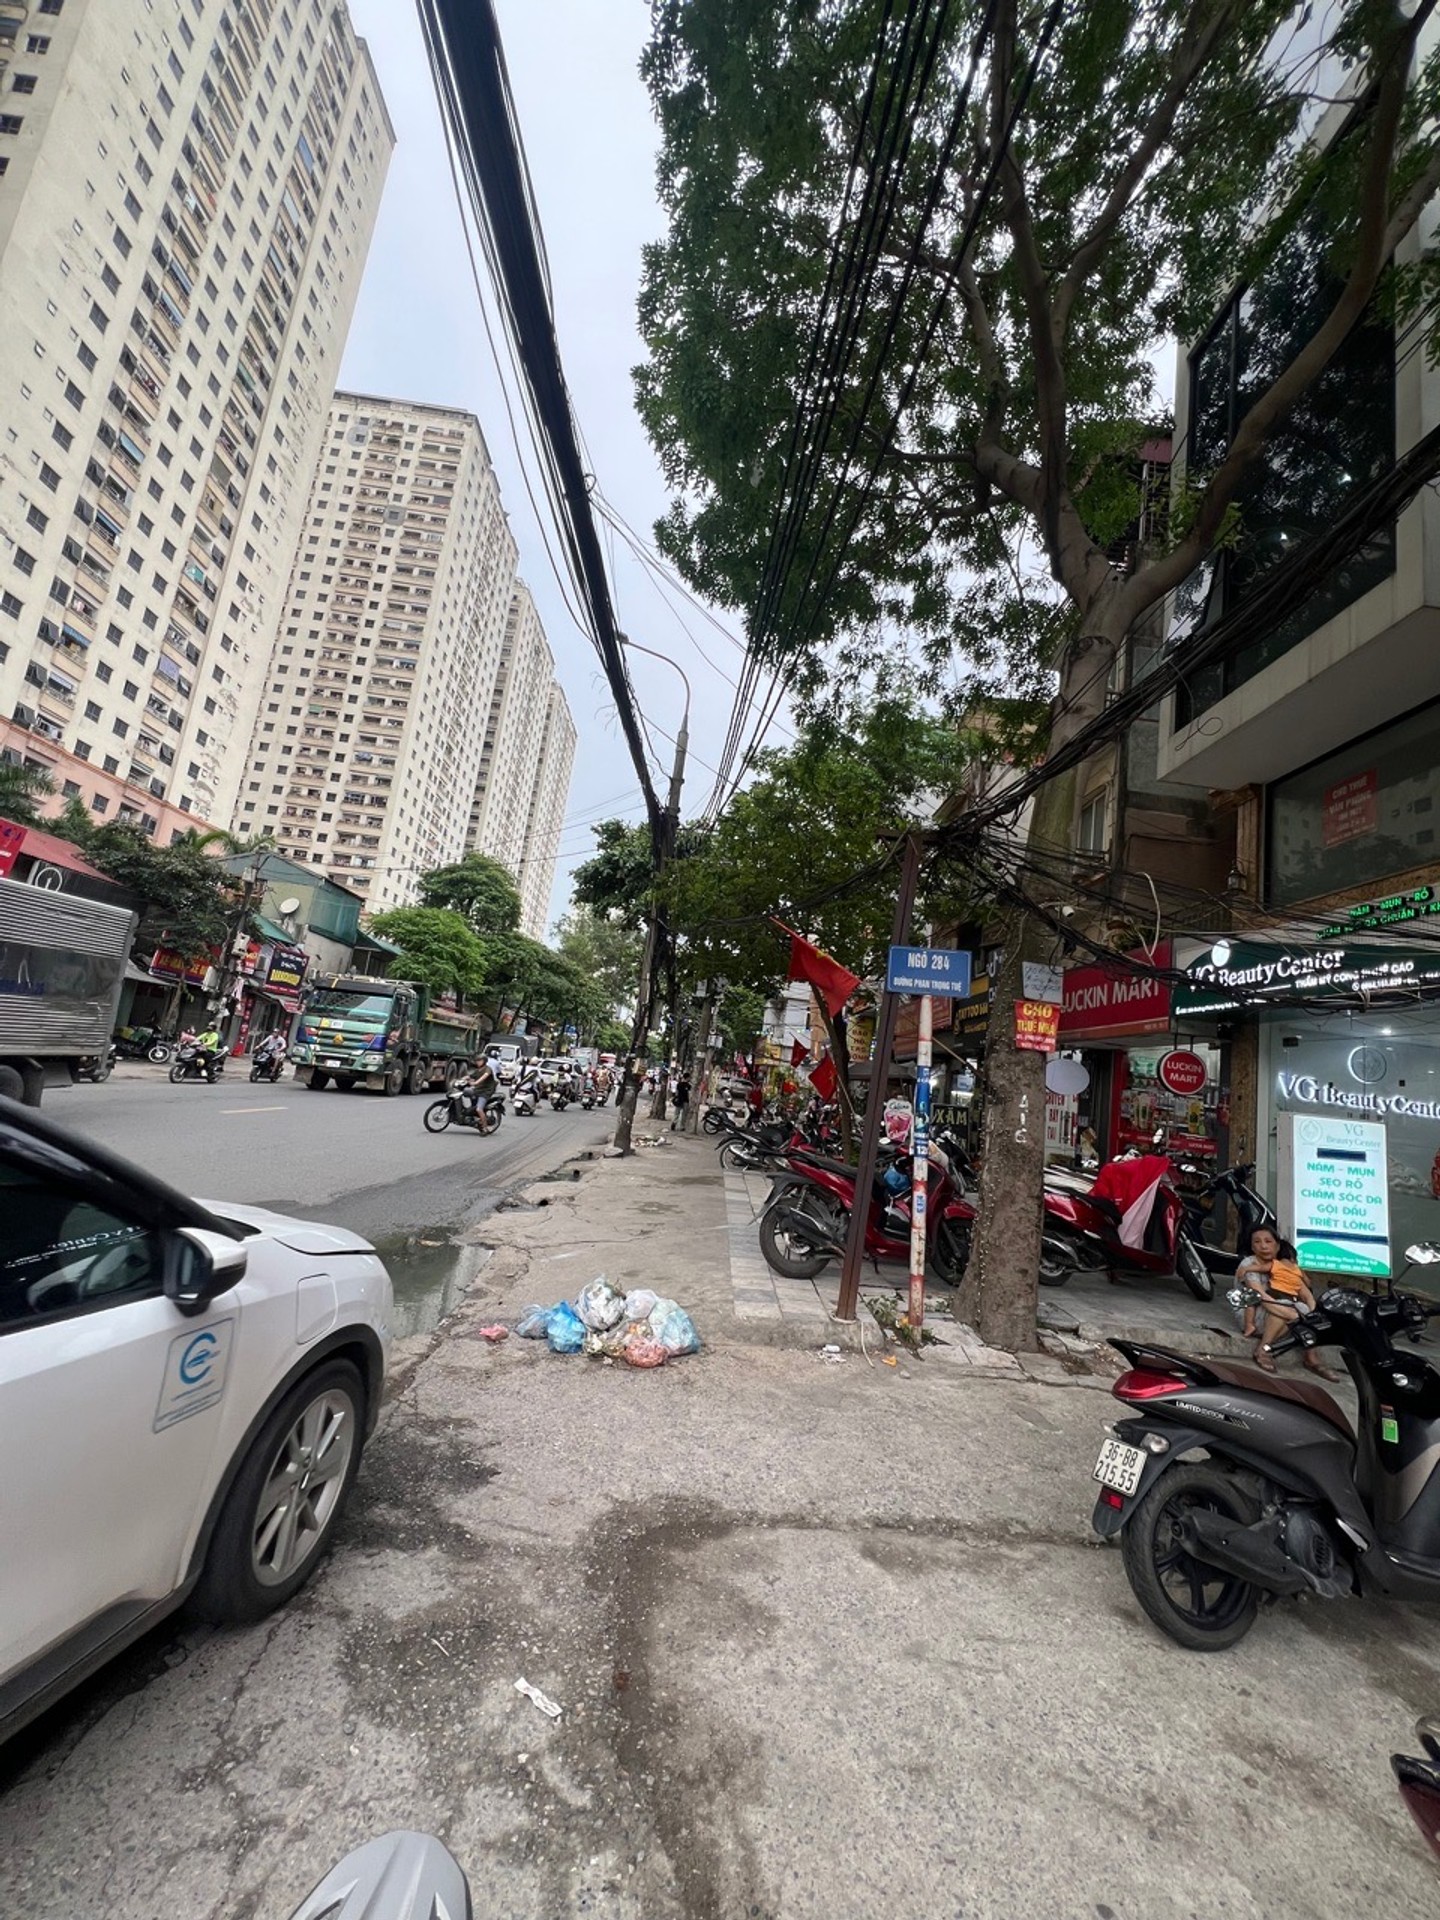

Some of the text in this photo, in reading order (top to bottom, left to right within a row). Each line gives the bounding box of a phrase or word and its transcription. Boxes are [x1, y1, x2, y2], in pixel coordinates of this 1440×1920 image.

[907, 950, 951, 971] NGÕ 284
[1390, 961, 1415, 975] CAO
[914, 979, 930, 989] PHAN
[1061, 983, 1108, 1014] UCKIN
[1023, 1003, 1053, 1019] CHO
[1166, 1060, 1202, 1073] LUCKIN
[1169, 1072, 1198, 1084] MART
[1278, 1072, 1320, 1102] VG
[1344, 1124, 1364, 1137] VG
[1366, 1195, 1382, 1205] DA
[1175, 1400, 1202, 1414] LIMITED
[1095, 1461, 1137, 1493] 215.55
